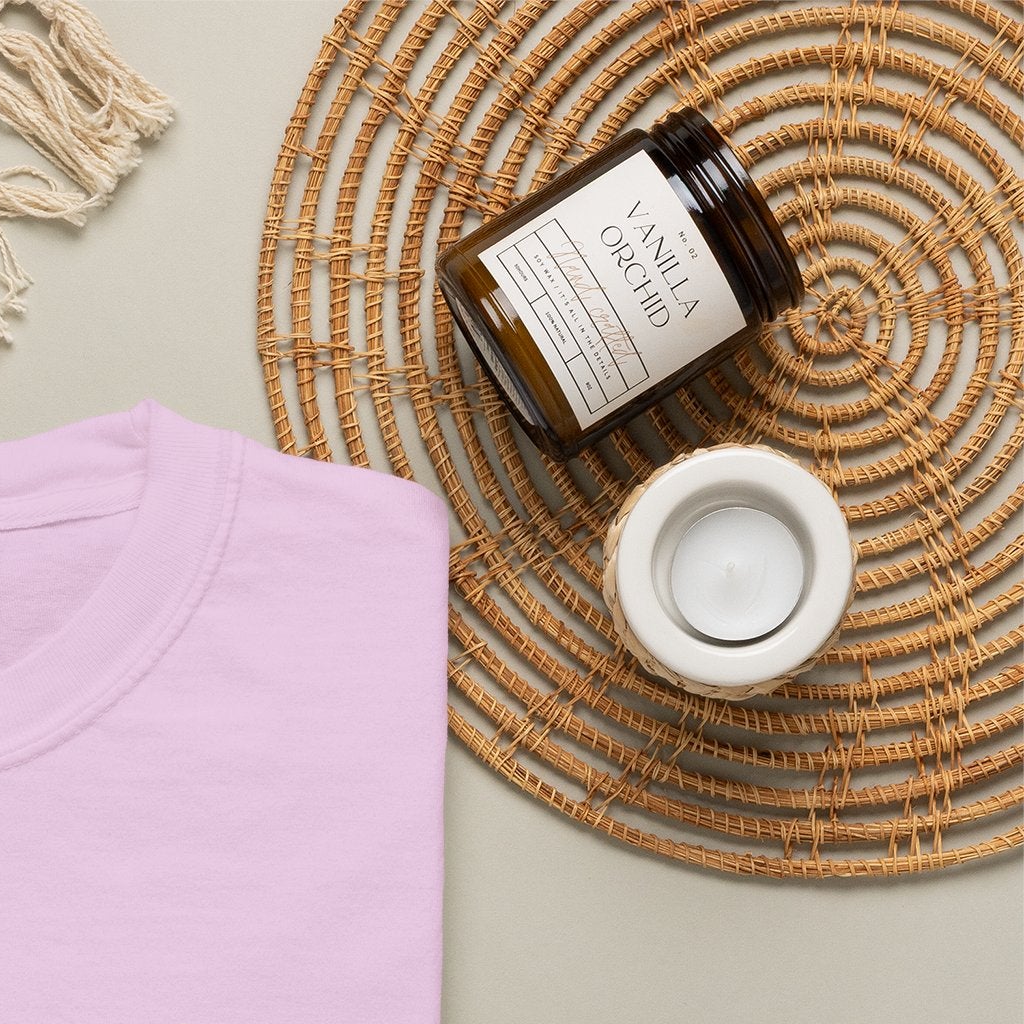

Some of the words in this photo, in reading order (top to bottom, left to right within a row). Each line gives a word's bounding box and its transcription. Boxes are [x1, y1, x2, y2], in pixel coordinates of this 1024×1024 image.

[600, 225, 671, 328] ORCHID
[627, 200, 700, 319] VANILLA
[678, 230, 689, 245] No.
[687, 248, 698, 260] 02
[533, 254, 544, 267] SOY
[543, 269, 554, 283] WAX
[558, 291, 569, 306] IT'S
[569, 309, 578, 322] ALL
[578, 324, 586, 334] IN
[585, 335, 595, 349] THE
[594, 351, 611, 381] DETAILS
[553, 324, 567, 345] NATURAL
